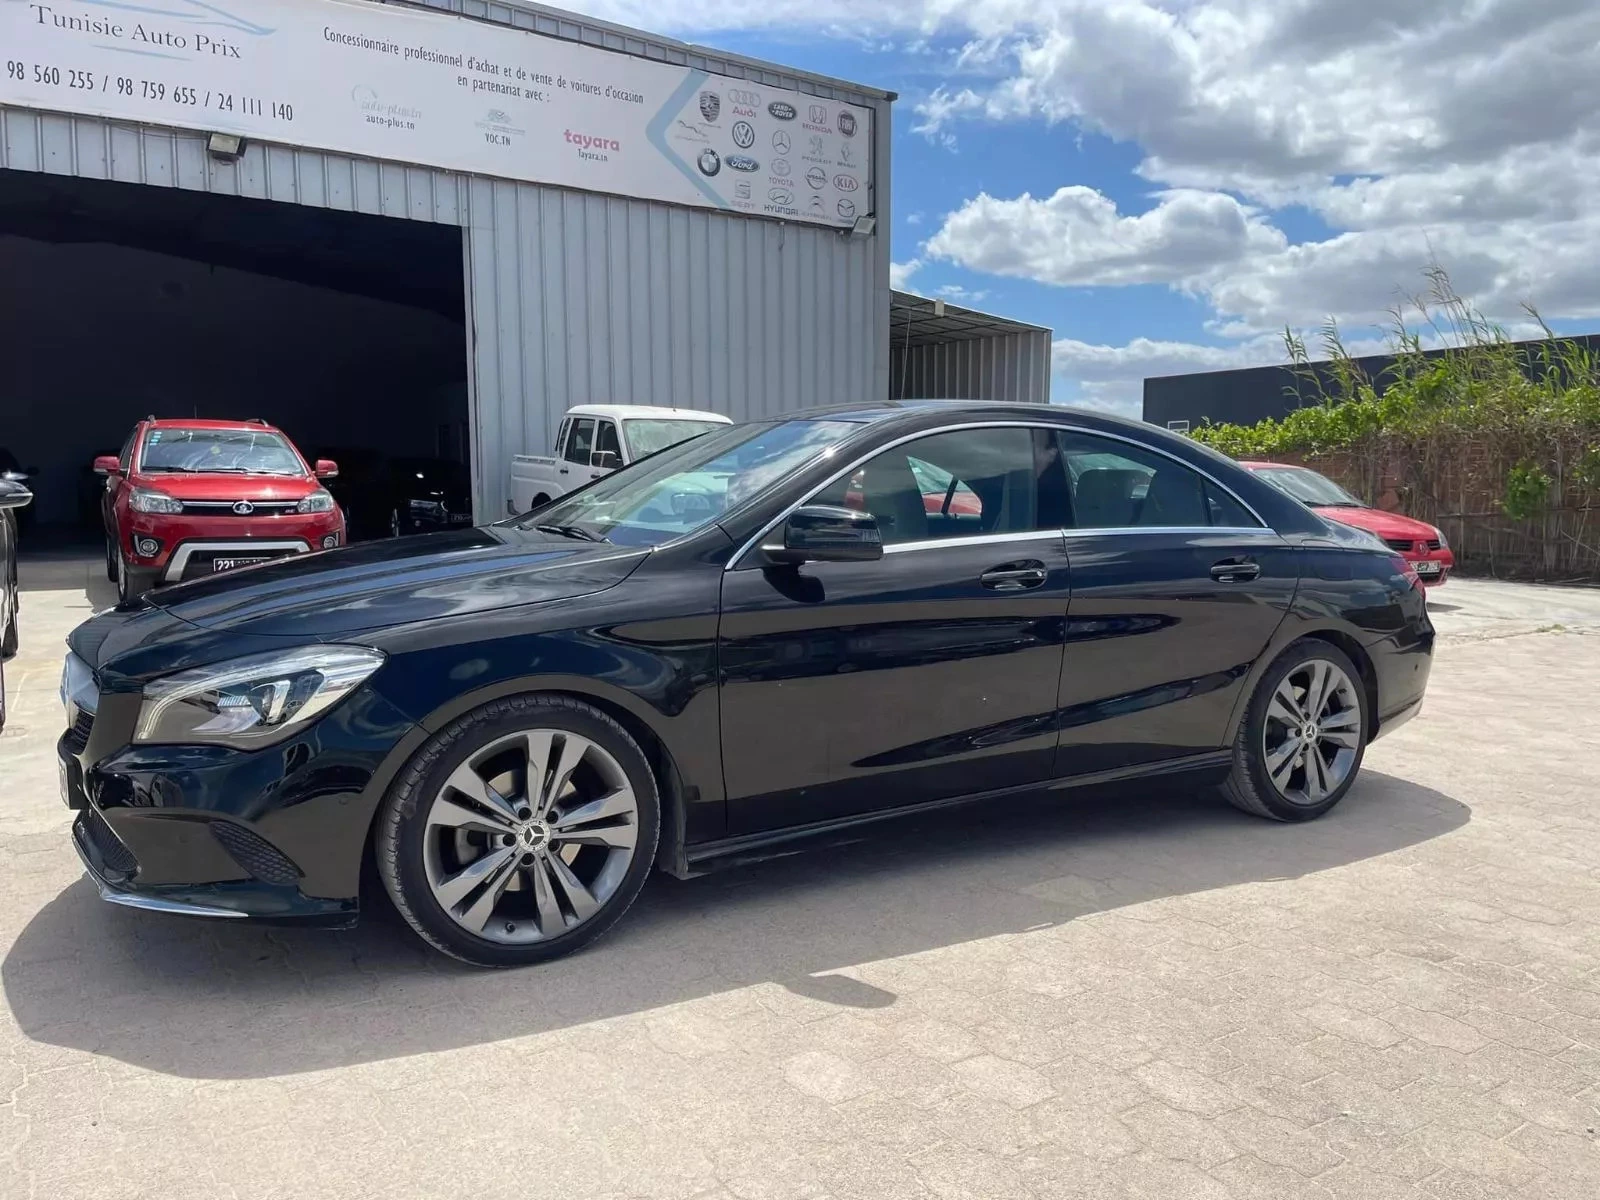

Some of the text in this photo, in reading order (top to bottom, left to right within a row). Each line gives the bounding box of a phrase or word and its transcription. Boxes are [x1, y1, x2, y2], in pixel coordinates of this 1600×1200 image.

[30, 4, 241, 58] Tunisie Auto Prix
[323, 26, 644, 104] Concessionnaire professionnel d'achat et de vente de voitures d'occasion
[7, 60, 25, 80] 98
[34, 64, 60, 85] 560
[68, 69, 94, 90] 255
[117, 77, 133, 96] 98
[141, 80, 165, 100] 759
[173, 86, 196, 105] 655
[218, 93, 233, 112] 24
[243, 97, 262, 116] 111
[272, 101, 293, 121] 140
[457, 75, 468, 87] en
[473, 79, 521, 97] partenariat
[525, 89, 543, 101] avec
[366, 115, 415, 130] auto-plus.tn
[802, 122, 832, 135] HONDA
[563, 128, 620, 152] tayara
[769, 176, 794, 187] TOYOTA
[837, 177, 854, 189] KIA
[763, 204, 799, 216] HYUNDAI
